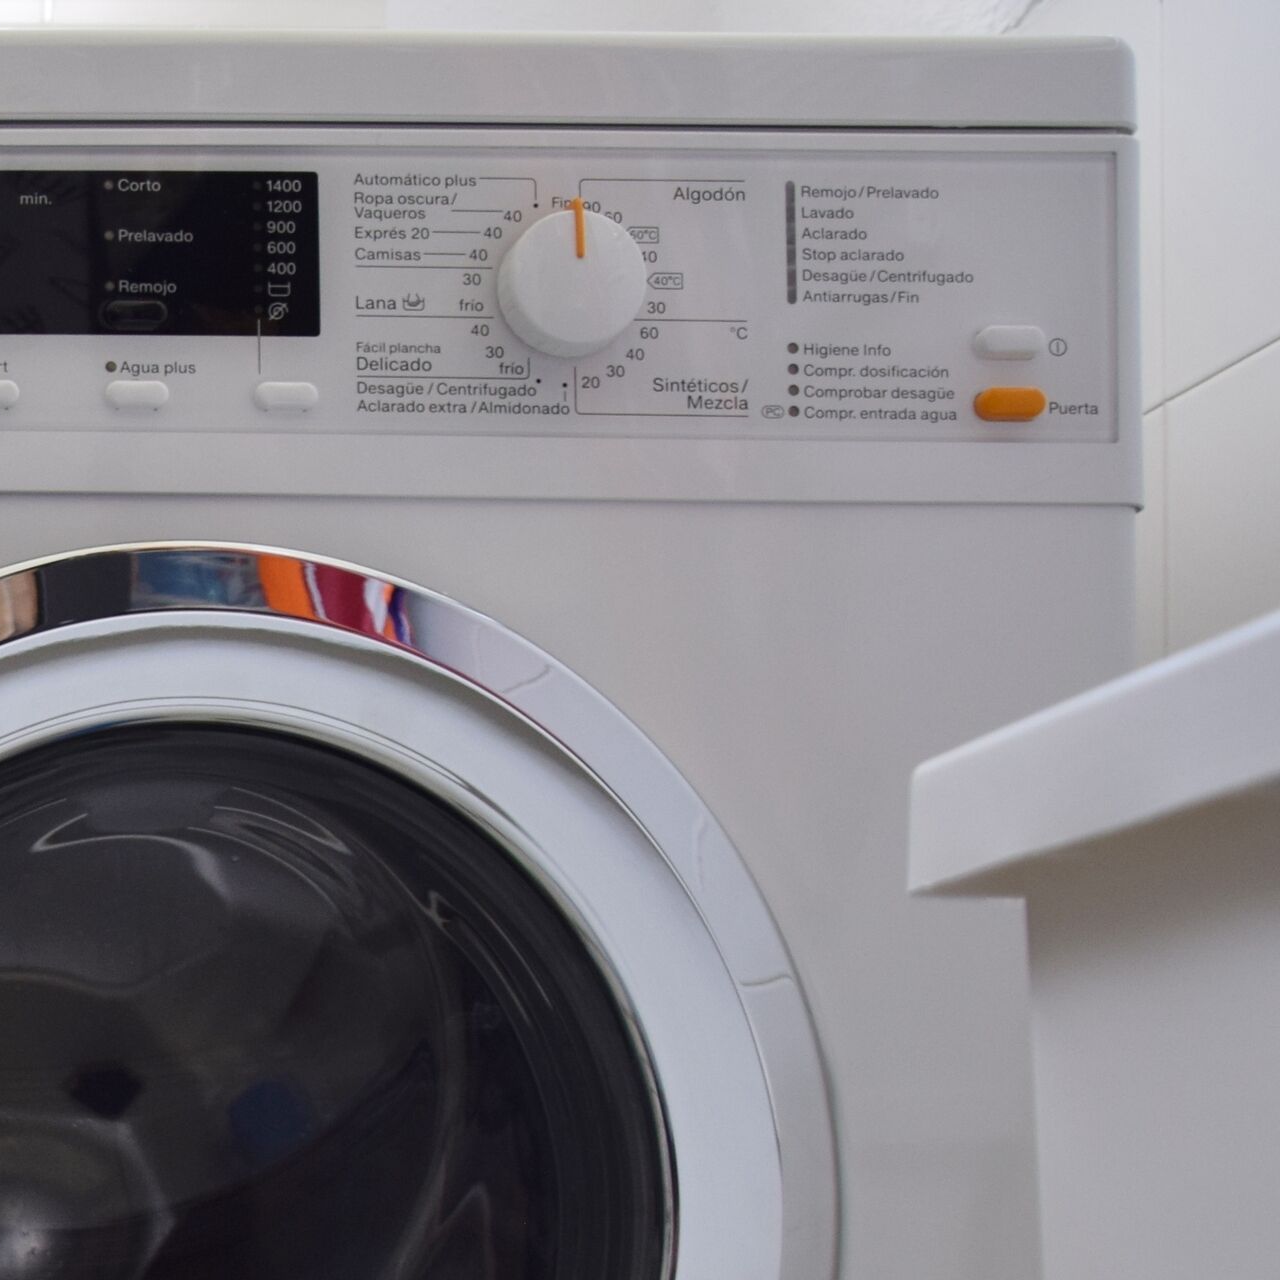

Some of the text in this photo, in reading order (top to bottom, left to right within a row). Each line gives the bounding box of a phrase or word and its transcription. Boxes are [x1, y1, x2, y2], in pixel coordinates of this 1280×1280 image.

[118, 179, 161, 192] Corto
[266, 180, 302, 193] 1400
[354, 173, 477, 188] Automático plus
[354, 192, 395, 207] Ropa
[673, 187, 745, 204] Algodón
[266, 200, 303, 214] 1200
[802, 207, 854, 219] Lavado
[354, 207, 426, 222] Vaqueros
[504, 211, 522, 222] 40
[266, 221, 296, 234] 900
[355, 227, 430, 241] Exprés 20
[484, 227, 503, 239] 40
[118, 229, 194, 243] Prelavado
[802, 228, 868, 241] Aclarado
[266, 241, 296, 255] 600
[354, 248, 421, 261] Camisas
[469, 249, 488, 261] 40
[802, 250, 904, 263] Stop aclarado
[266, 262, 297, 275] 400
[463, 273, 481, 286] 30
[119, 280, 177, 294] Remojo
[355, 296, 397, 310] Lana
[648, 302, 666, 314] 30
[471, 325, 489, 337] 40
[640, 327, 659, 339] 60
[356, 342, 441, 354] Fácil plancha
[486, 346, 504, 358] 30
[626, 348, 645, 361] 40
[803, 344, 891, 358] Higiene Info
[120, 360, 196, 376] Agua plus
[356, 357, 433, 371] Delicado
[606, 365, 625, 377] 30
[803, 365, 949, 380] Compr. dosificación
[581, 376, 600, 389] 20
[803, 387, 955, 402] Comprobar desagüe
[357, 400, 425, 413] Aclarado
[687, 395, 749, 411] Mezcla
[1049, 403, 1099, 415] Puerta
[804, 408, 857, 422] Compr.
[860, 408, 917, 421] entrada
[921, 409, 957, 423] agua
